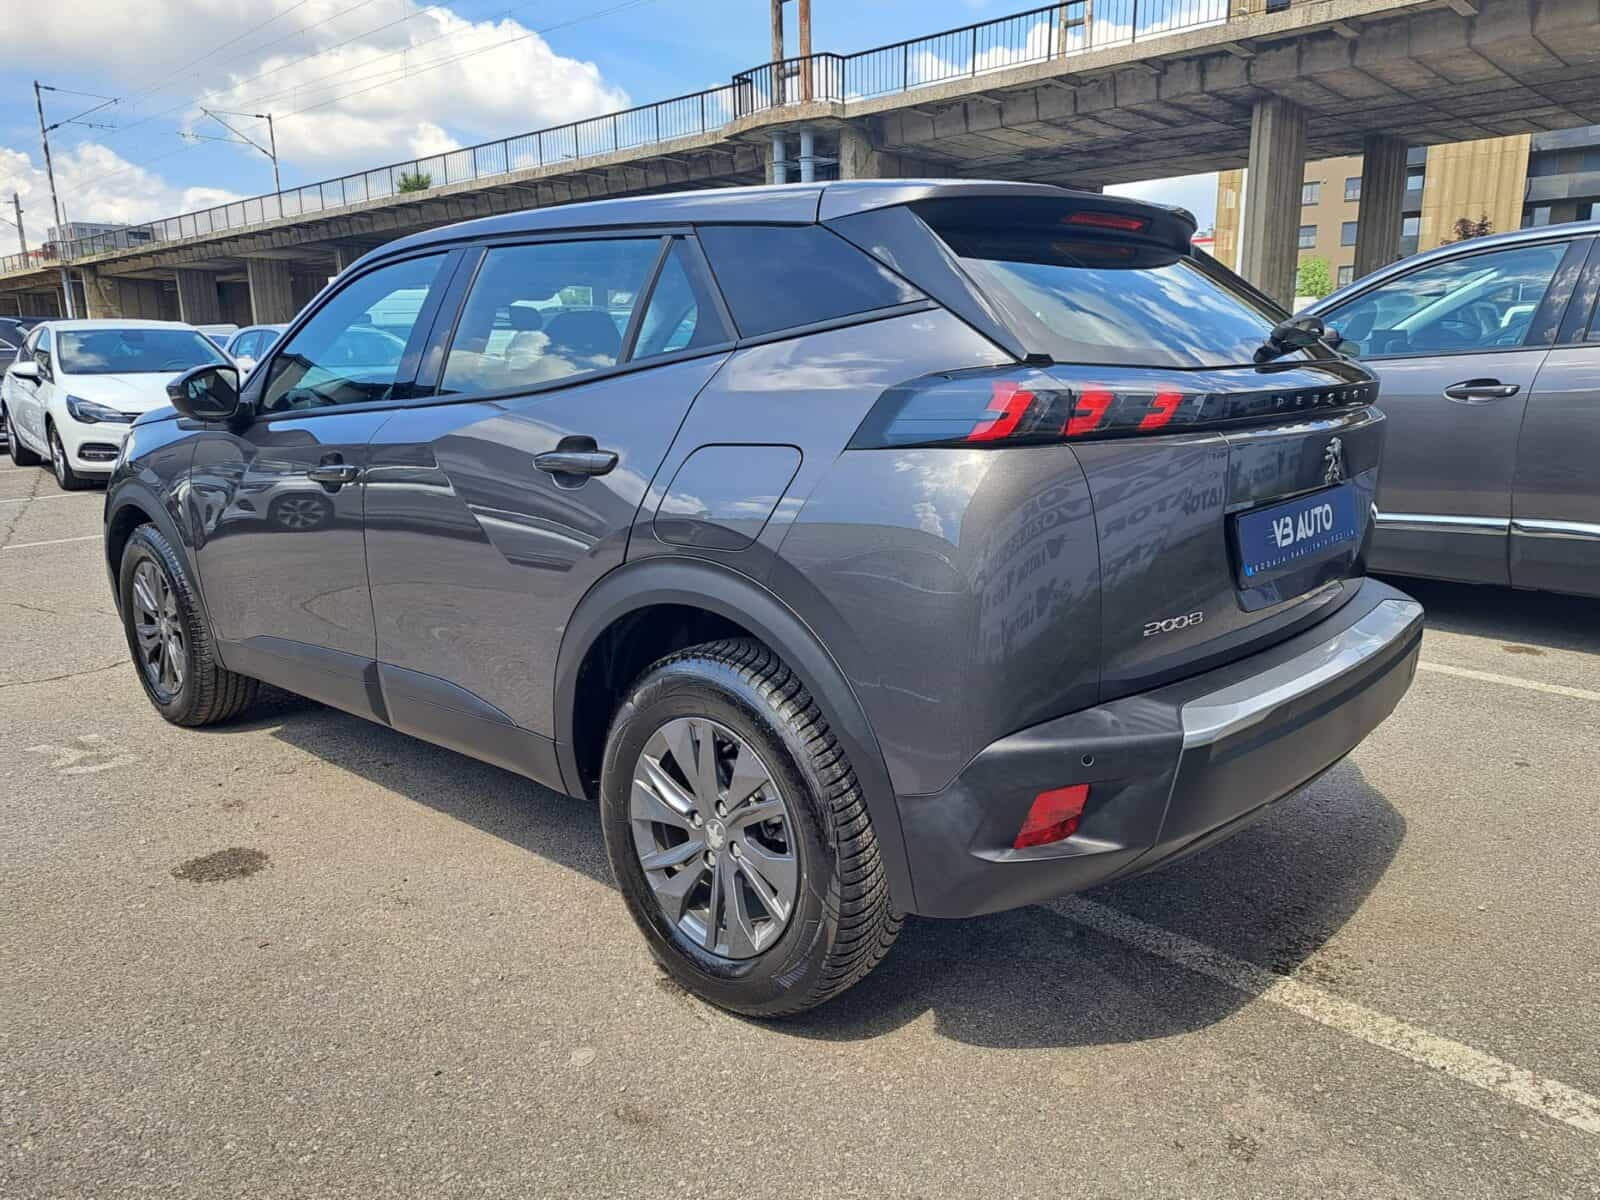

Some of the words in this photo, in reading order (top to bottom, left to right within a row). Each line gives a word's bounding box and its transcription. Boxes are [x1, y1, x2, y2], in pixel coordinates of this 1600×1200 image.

[1276, 387, 1369, 408] PEUGEOT
[1296, 503, 1333, 542] AUTO
[1143, 611, 1204, 636] 2008
